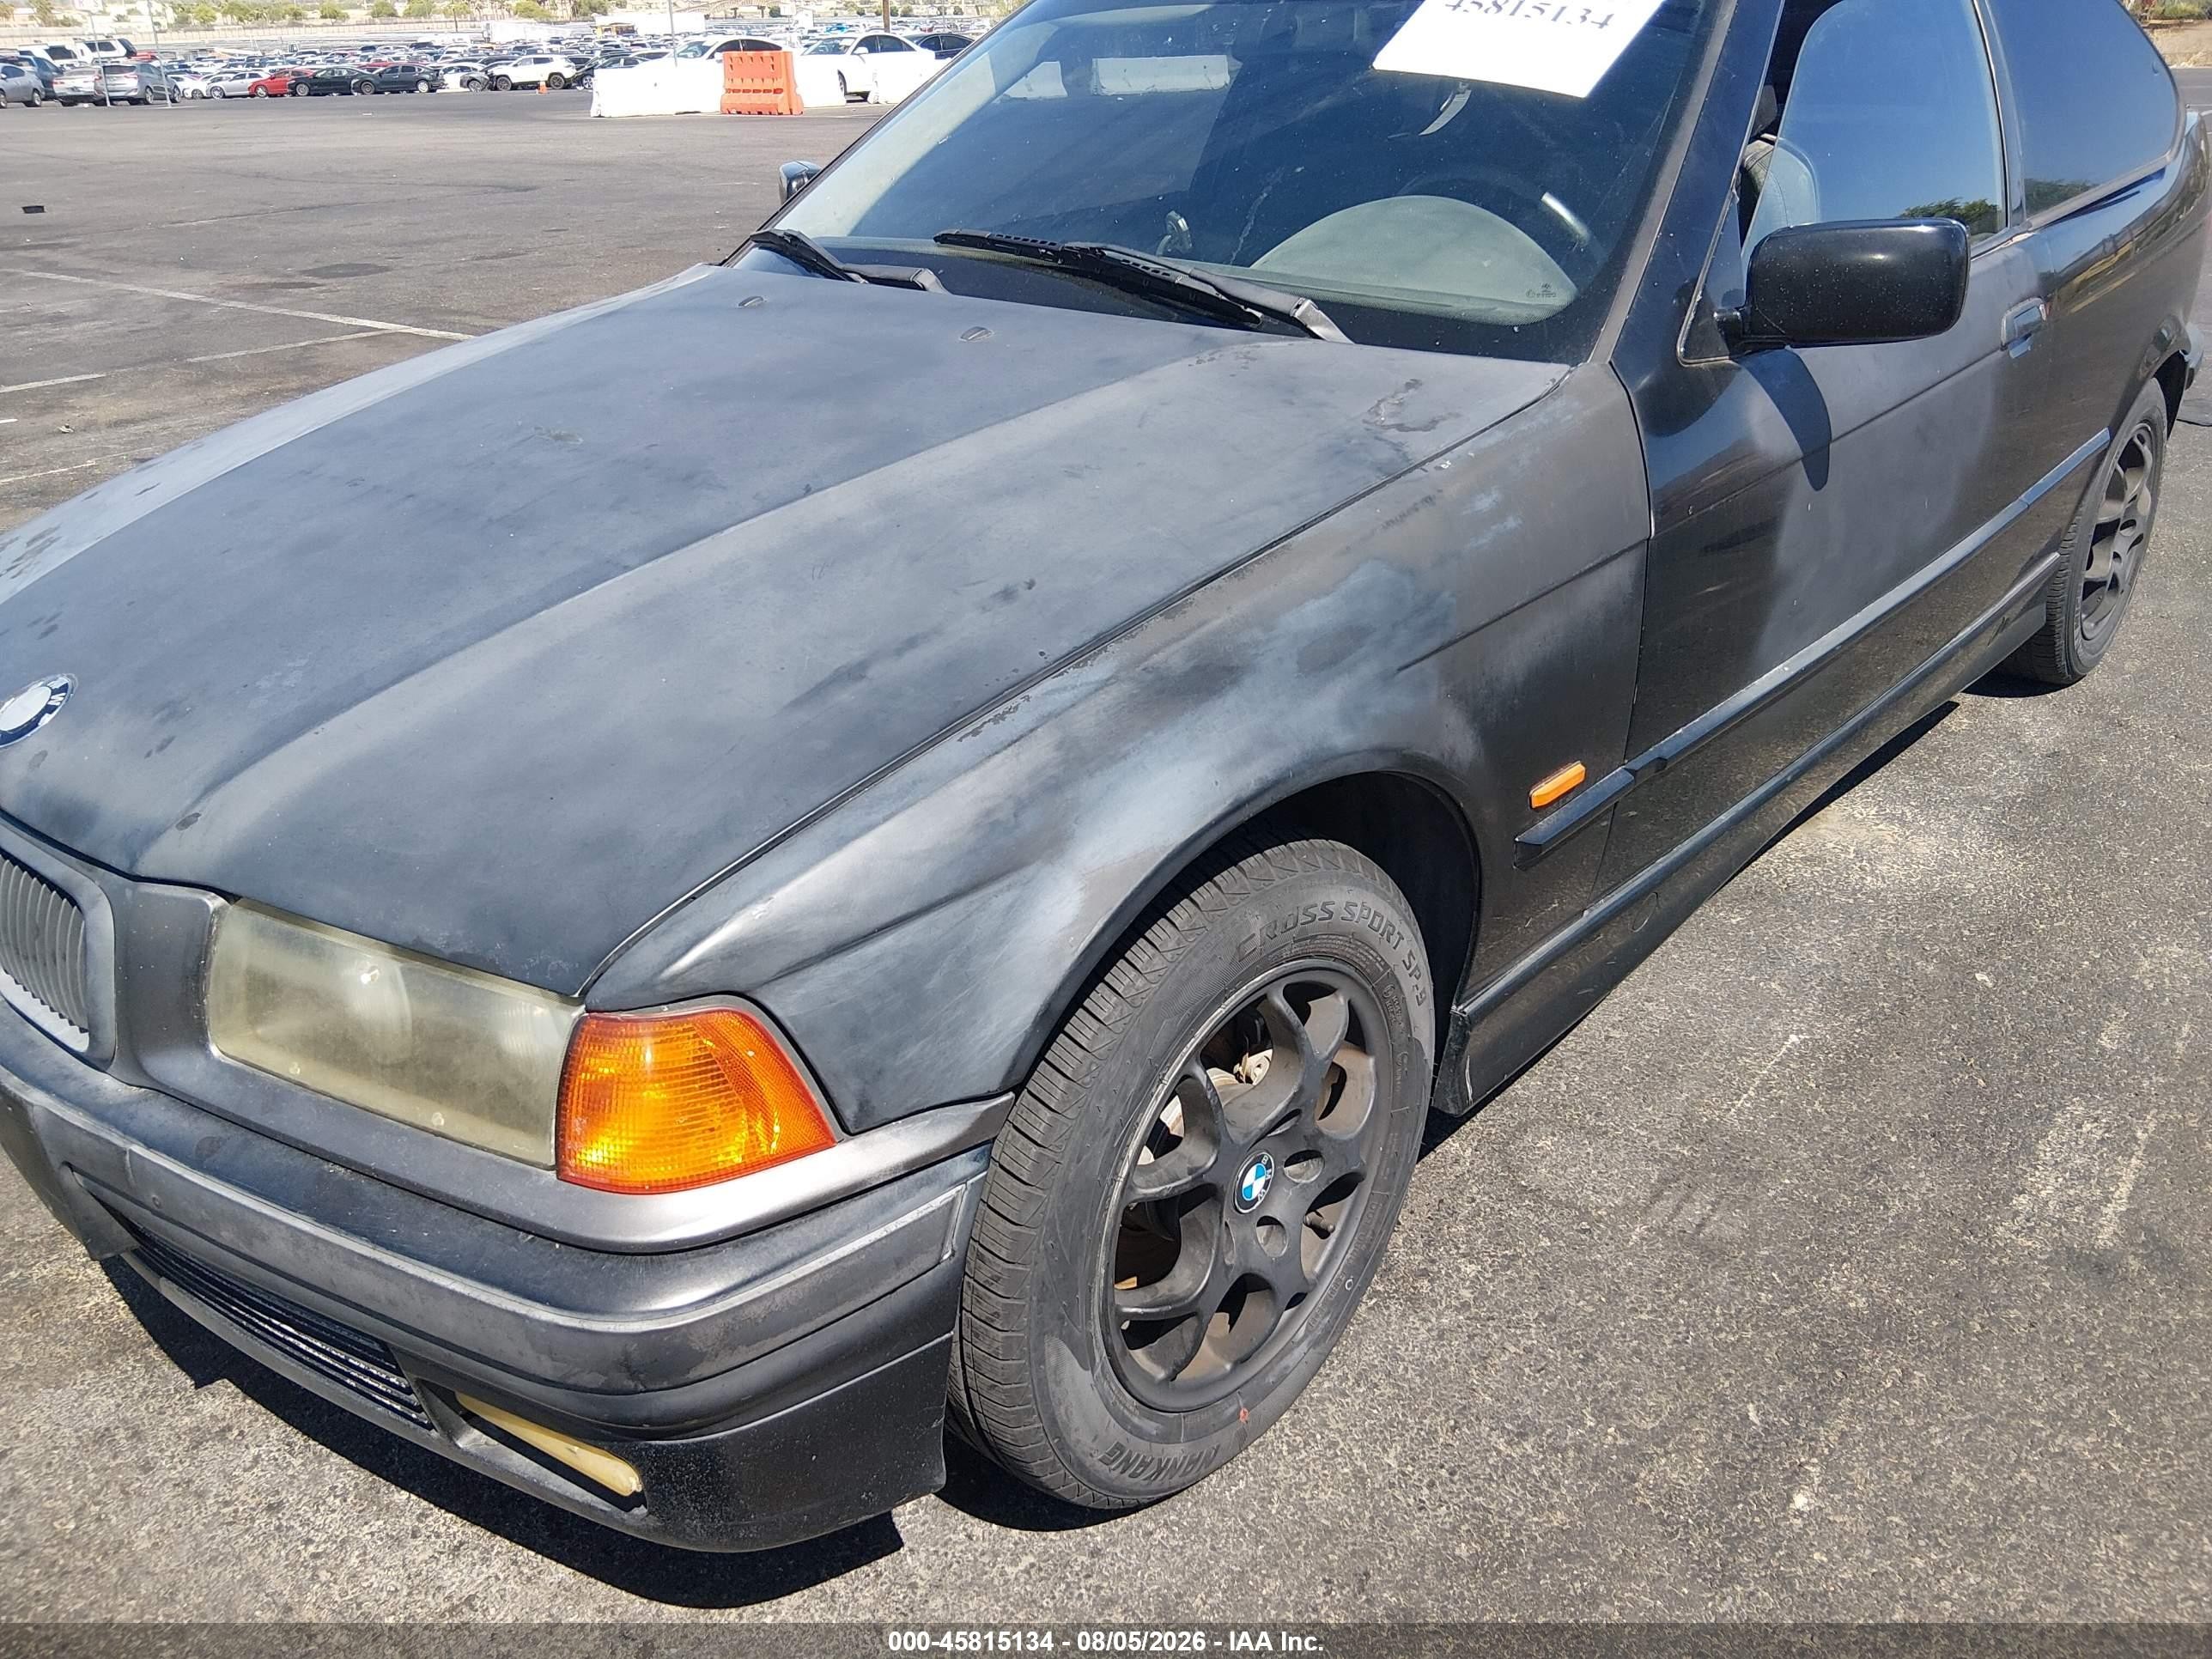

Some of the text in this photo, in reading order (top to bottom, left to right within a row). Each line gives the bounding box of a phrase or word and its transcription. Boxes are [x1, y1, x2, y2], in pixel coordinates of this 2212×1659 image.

[1236, 901, 1335, 962] CROSS
[1341, 902, 1404, 950] SPORT
[1097, 1441, 1220, 1481] NANKANG
